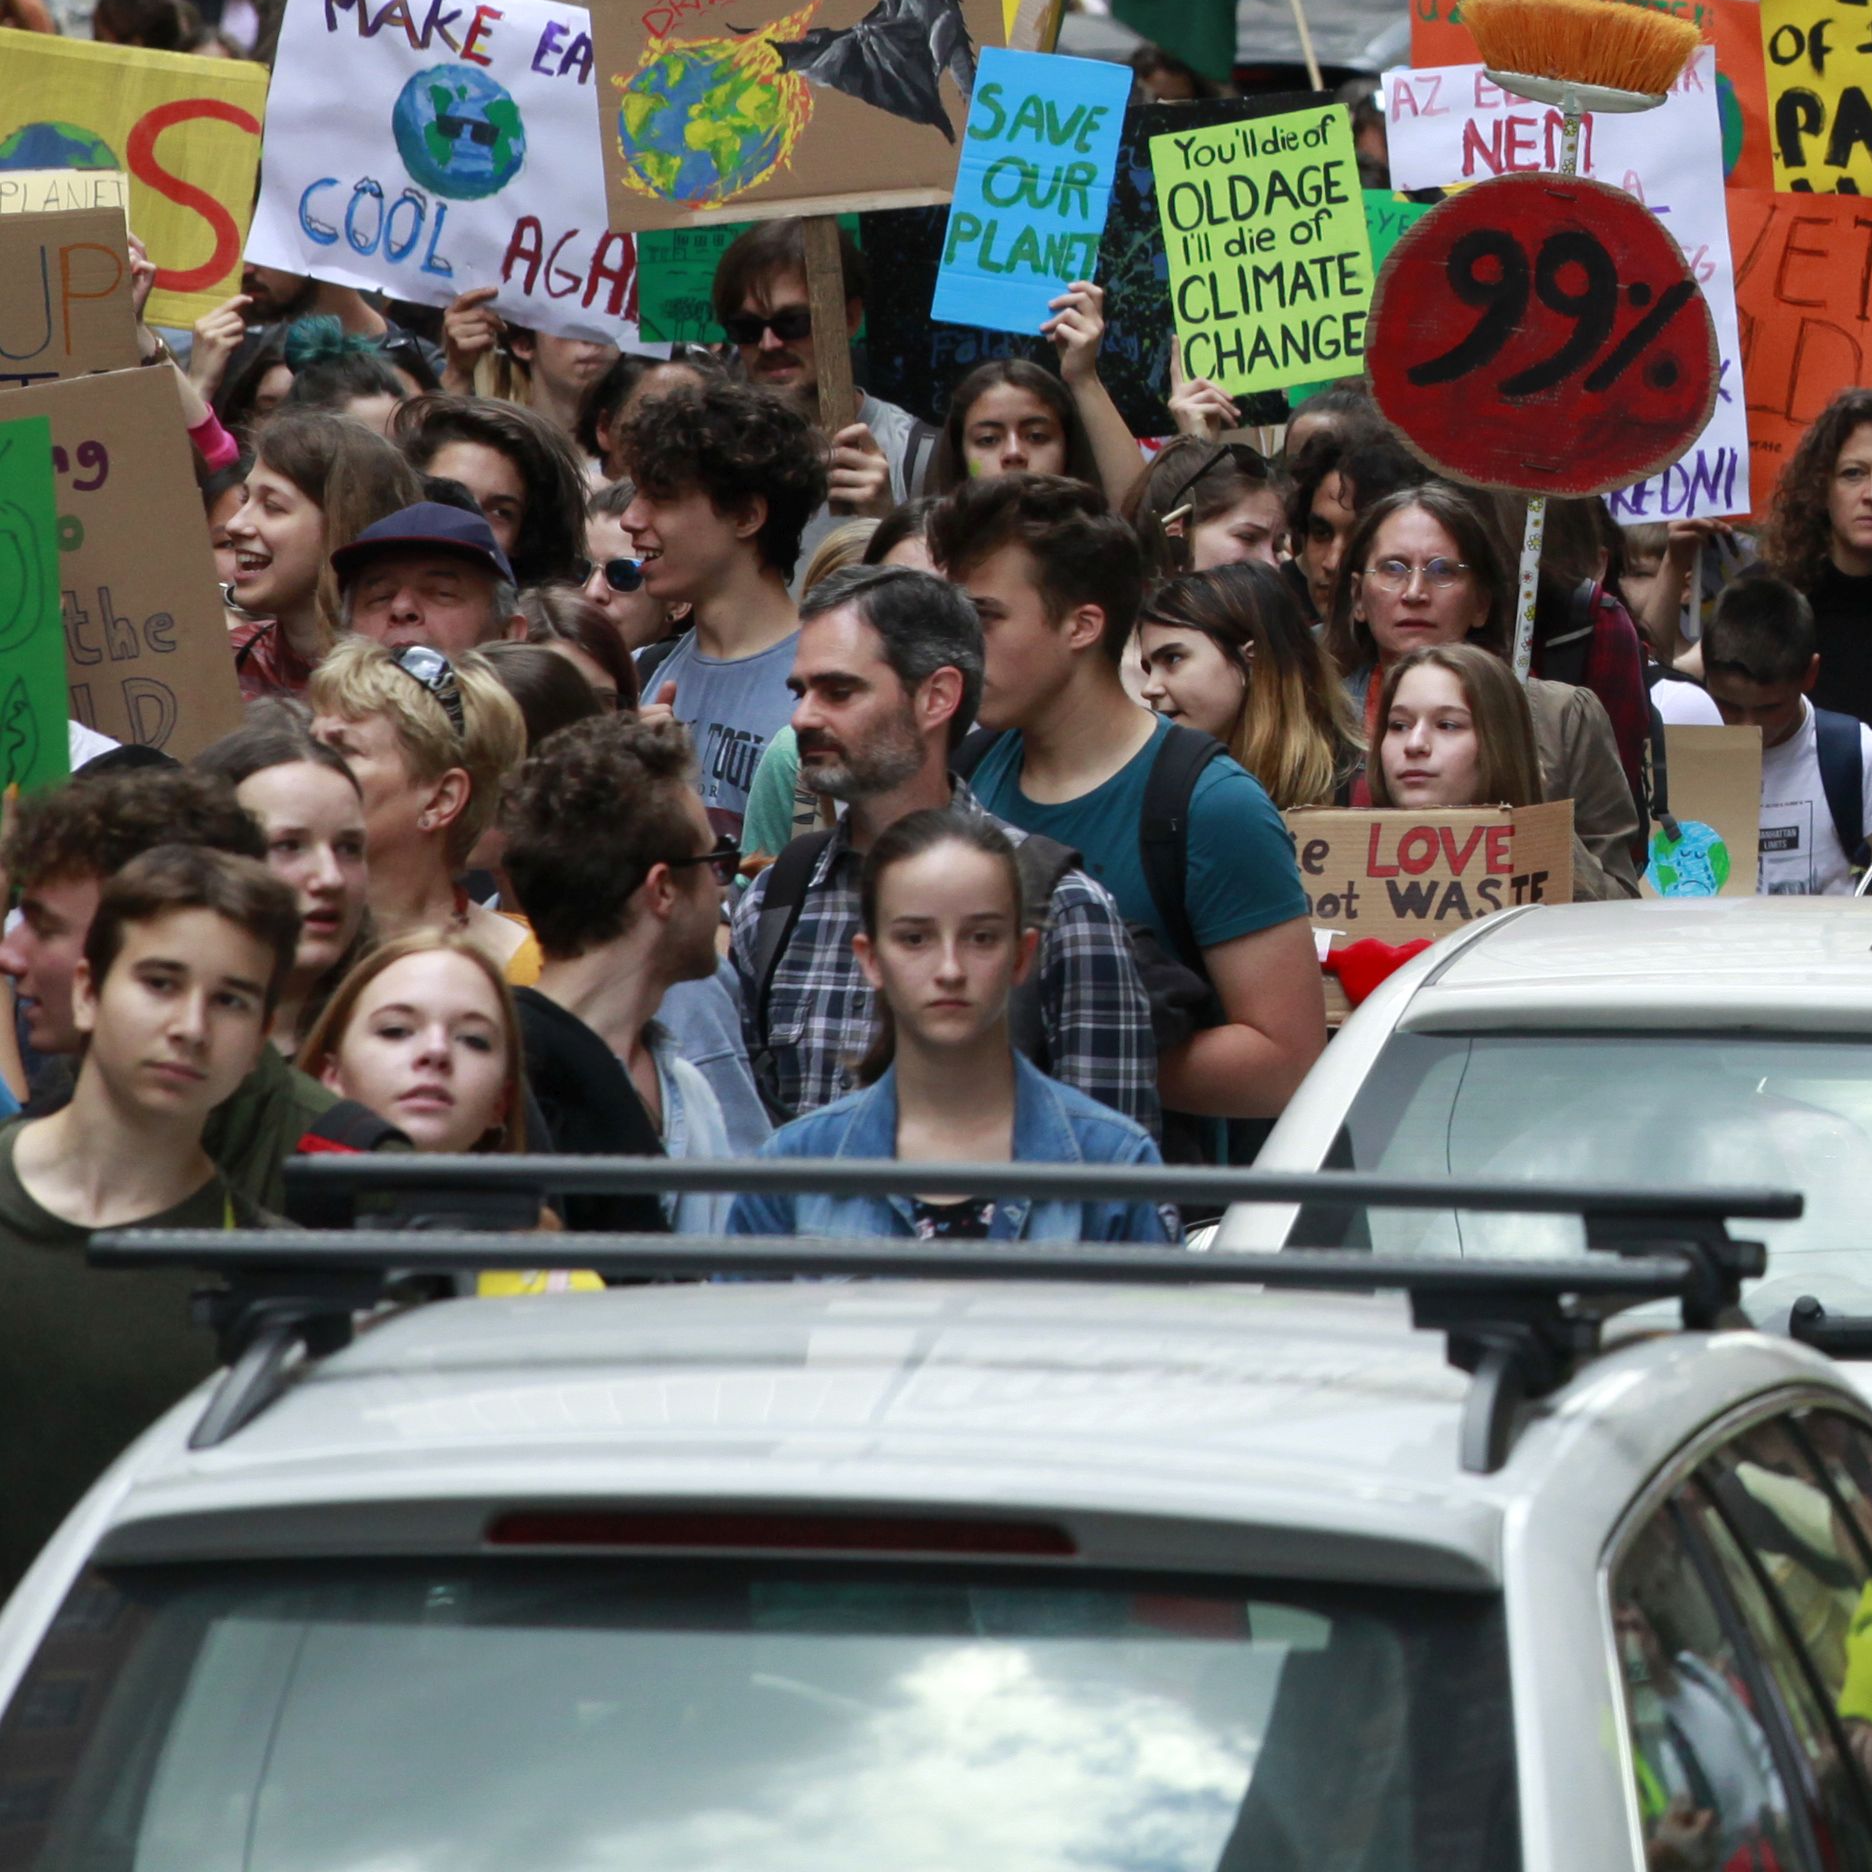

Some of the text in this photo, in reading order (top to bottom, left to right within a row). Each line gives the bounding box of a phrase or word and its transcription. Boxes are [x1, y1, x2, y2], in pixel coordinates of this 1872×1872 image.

[966, 82, 1111, 154] SAVE
[1261, 122, 1300, 156] die
[1302, 113, 1337, 148] of
[1461, 108, 1595, 177] NEM
[980, 157, 1099, 221] OUR
[943, 211, 1101, 285] PLANET
[1223, 226, 1278, 259] die
[1288, 208, 1333, 247] of
[500, 215, 640, 329] AGA
[1176, 250, 1364, 325] CLIMATE
[1183, 310, 1368, 384] CHANGE
[1407, 228, 1699, 397] 99%
[1366, 822, 1516, 878] LOVE
